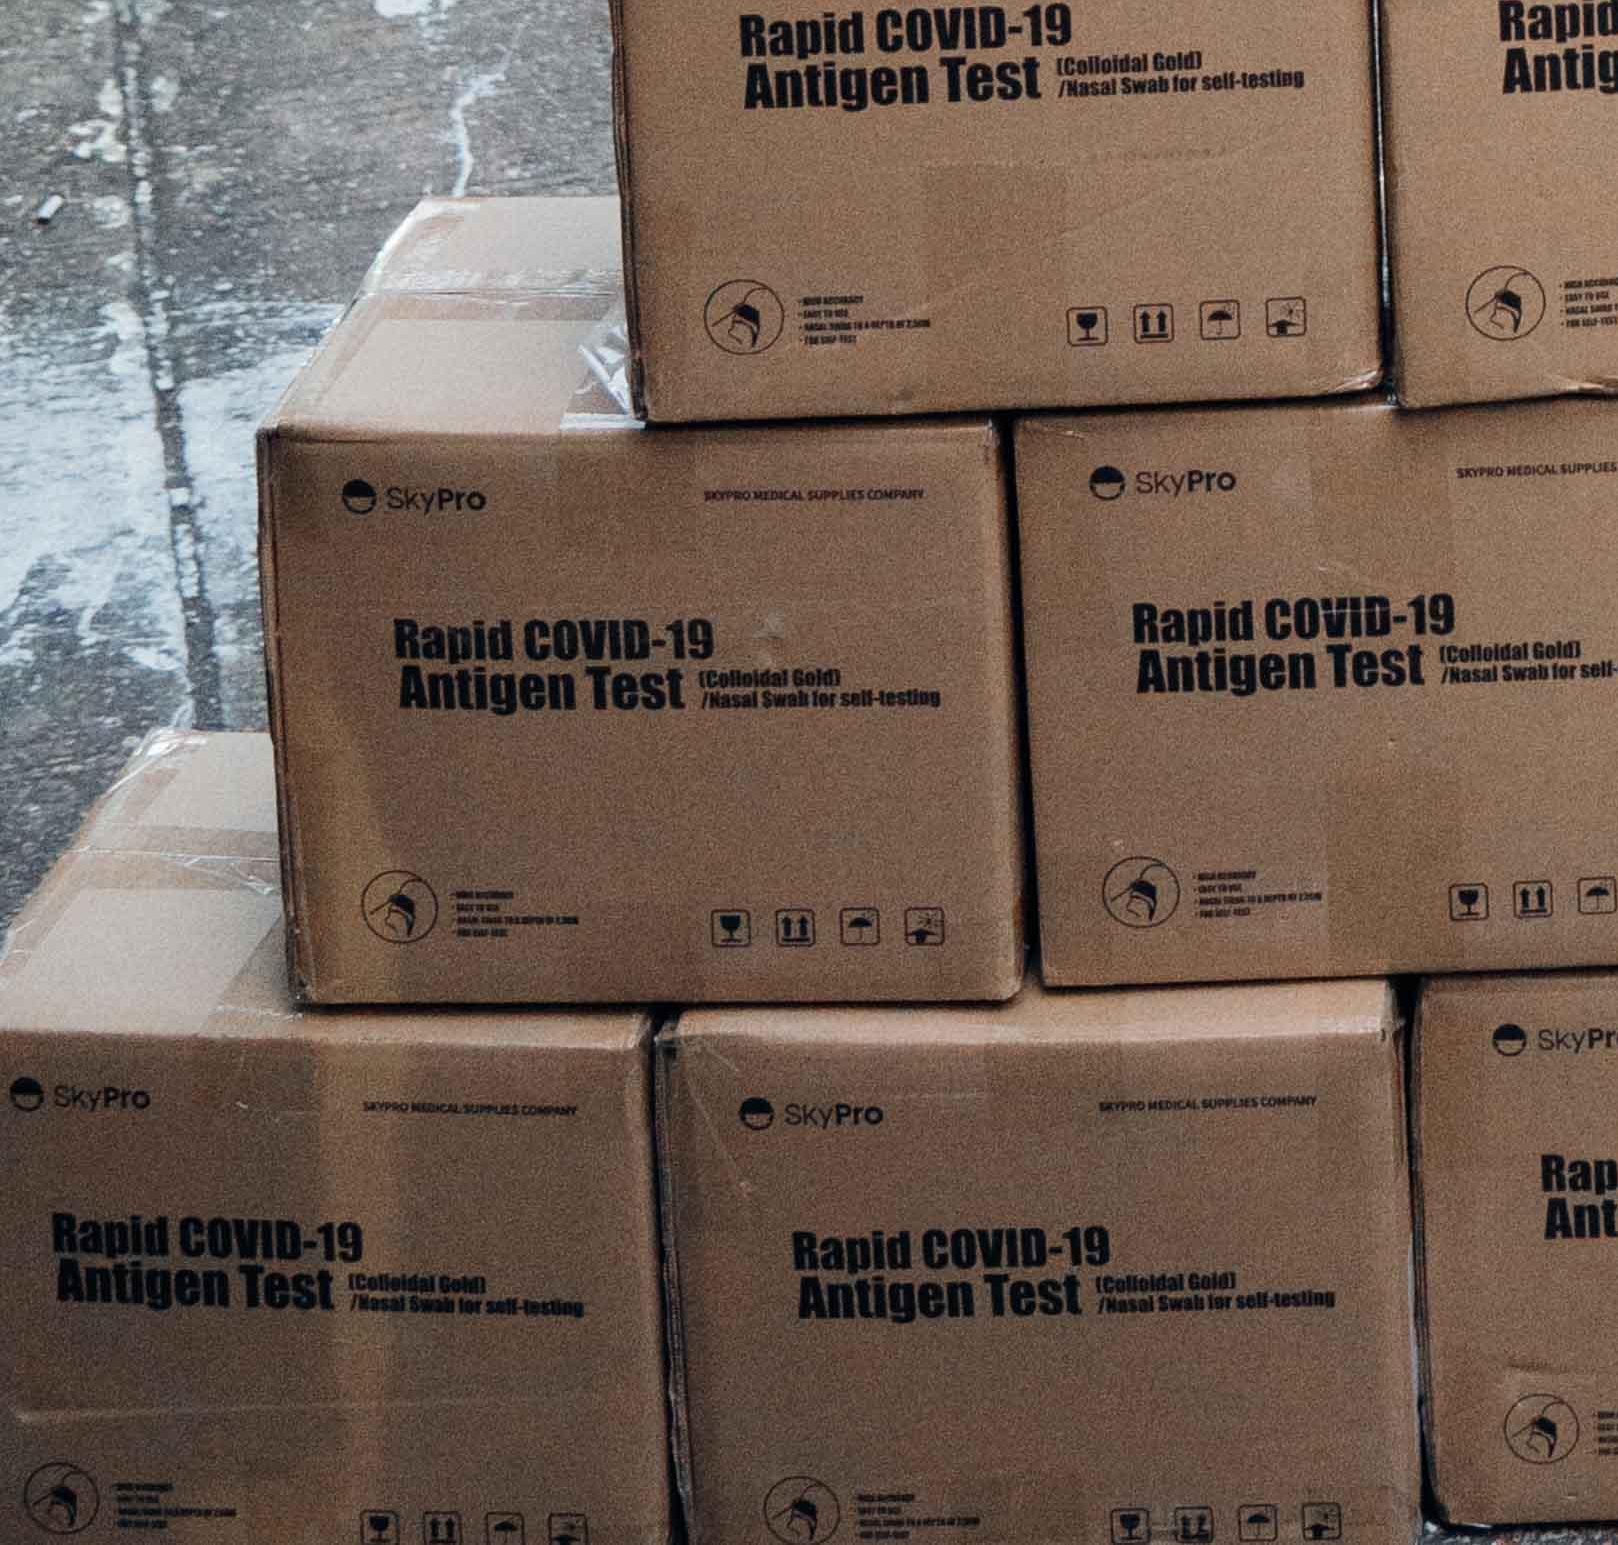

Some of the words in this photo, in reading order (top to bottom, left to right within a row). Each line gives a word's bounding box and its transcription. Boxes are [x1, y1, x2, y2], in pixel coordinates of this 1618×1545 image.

[739, 11, 864, 60] Rapid
[876, 3, 1074, 52] COVID-19
[742, 61, 930, 112] Antigen
[940, 56, 1043, 102] Test
[386, 487, 486, 514] SkyPro
[1135, 470, 1236, 498] SkyPro
[392, 620, 513, 665] Rapid
[522, 617, 712, 660] COVID-19
[1132, 600, 1253, 647] Rapid
[1264, 593, 1455, 640] COVID-19
[400, 666, 579, 716] Antigen
[586, 665, 688, 710] Test
[1136, 648, 1317, 697] Antigen
[1327, 643, 1426, 687] Test
[53, 1085, 151, 1113] SkyPro
[783, 1102, 884, 1130] SkyPro
[52, 1213, 168, 1259] Rapid
[179, 1216, 363, 1263] COVID-19
[791, 1230, 912, 1275] Rapid
[921, 1225, 1109, 1269] COVID-19
[56, 1259, 230, 1311] Antigen
[239, 1264, 335, 1311] Test
[800, 1276, 977, 1324] Antigen
[985, 1273, 1084, 1316] Test
